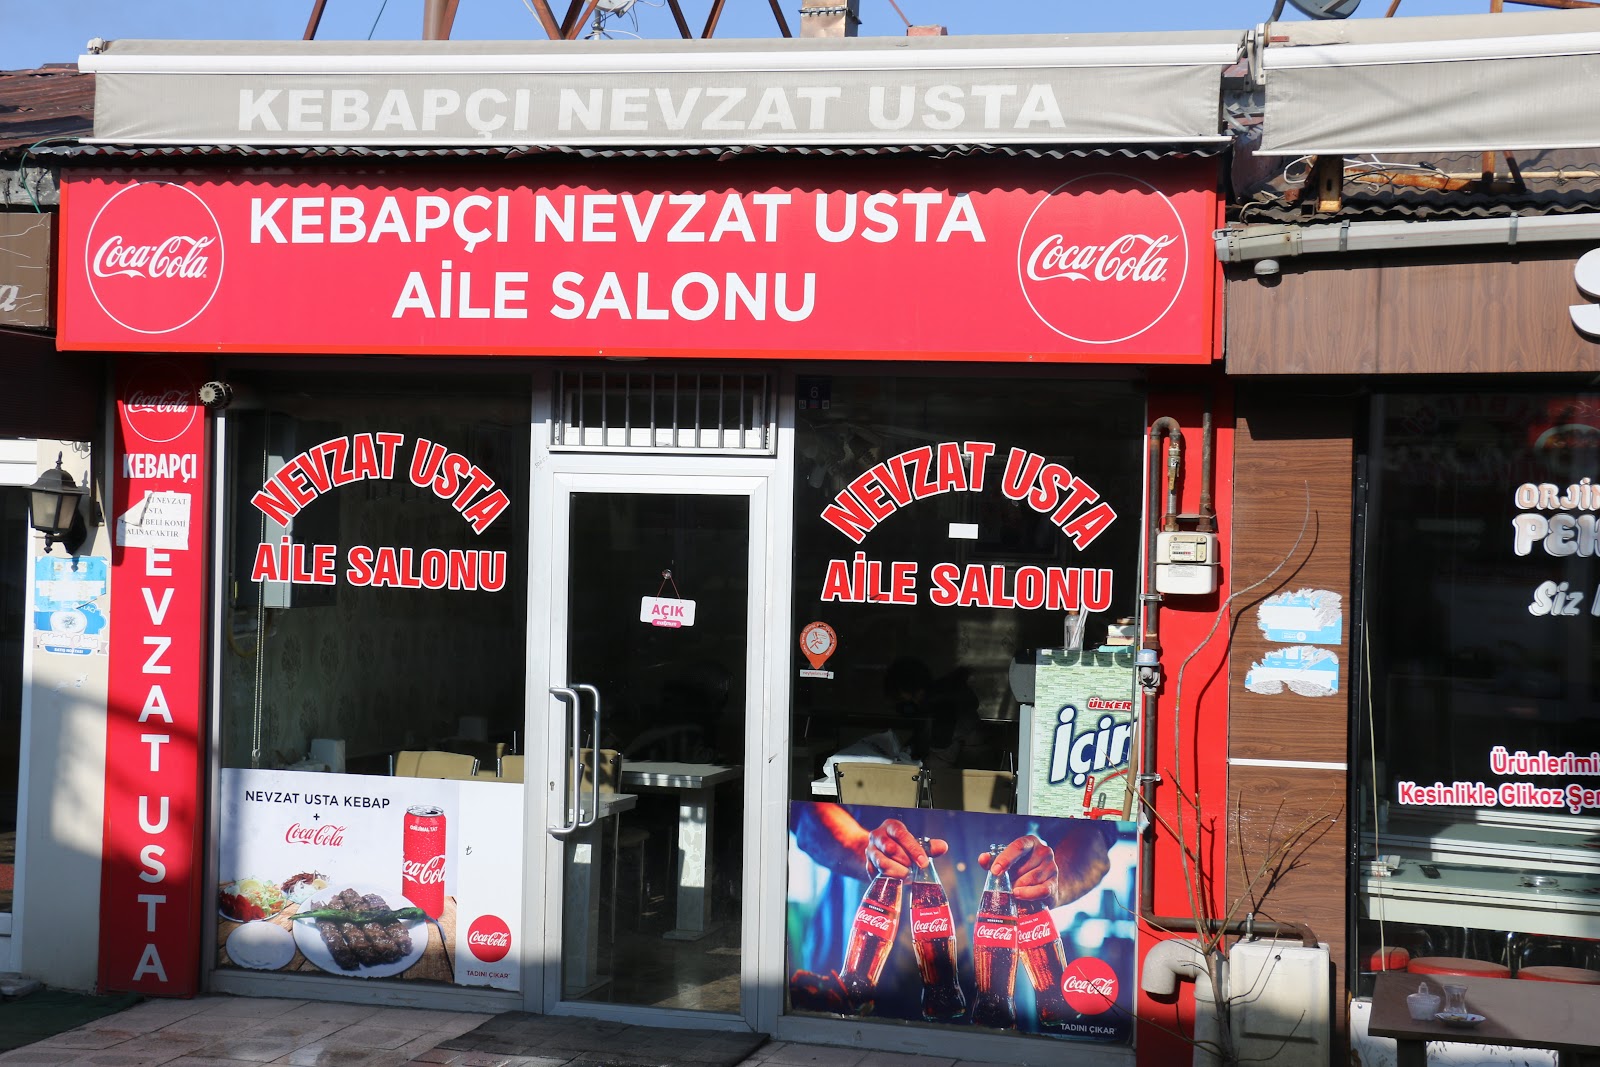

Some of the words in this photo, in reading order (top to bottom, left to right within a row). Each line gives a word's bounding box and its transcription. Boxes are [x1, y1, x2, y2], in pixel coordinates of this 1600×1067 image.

[238, 88, 531, 139] KEBAPÇI
[557, 86, 842, 131] NEVZAT
[868, 84, 1067, 129] USTA
[250, 195, 509, 253] KEBAPÇI
[534, 193, 792, 243] NEVZAT
[815, 192, 987, 243] USTA
[93, 235, 216, 278] Coca-Cola
[1026, 234, 1180, 282] Coca-Cola
[391, 260, 529, 319] AİLE
[550, 271, 816, 322] SALONU
[127, 390, 192, 413] Coca-Cola
[123, 453, 197, 483] KEBAPÇI
[251, 432, 404, 528] NEVZAT
[409, 438, 511, 535] USTA
[820, 441, 995, 544] NEVZAT
[1001, 447, 1117, 551] USTA
[156, 497, 187, 506] NEVZAT
[251, 535, 337, 585] AİLE
[347, 545, 507, 593] SALONU
[820, 551, 918, 605] AİLE
[929, 562, 1114, 612] SALONU
[651, 604, 684, 620] AÇIK
[1528, 580, 1584, 617] Siz
[138, 490, 175, 772] EVZAT
[1088, 698, 1132, 711] ÜLKER
[1490, 746, 1600, 776] Ürünlerimi
[245, 790, 300, 804] NEVZAT
[304, 793, 339, 806] USTA
[344, 796, 390, 809] KEBAP
[1398, 781, 1497, 806] Kesinlikle
[1499, 783, 1565, 808] Glikoz
[285, 822, 348, 847] Coca-Cola
[132, 795, 170, 982] USTA
[856, 910, 892, 931] Coca-Cola
[914, 918, 949, 933] Coca-Cola
[976, 925, 1014, 941] Coca-Cola
[469, 930, 510, 947] Coca-Cola
[466, 970, 487, 978] TADINI
[488, 971, 509, 980] ÇIKAR
[1063, 975, 1116, 996] Coca-Cola
[1060, 1023, 1087, 1032] TADINI
[1089, 1025, 1115, 1035] ÇIKAR
